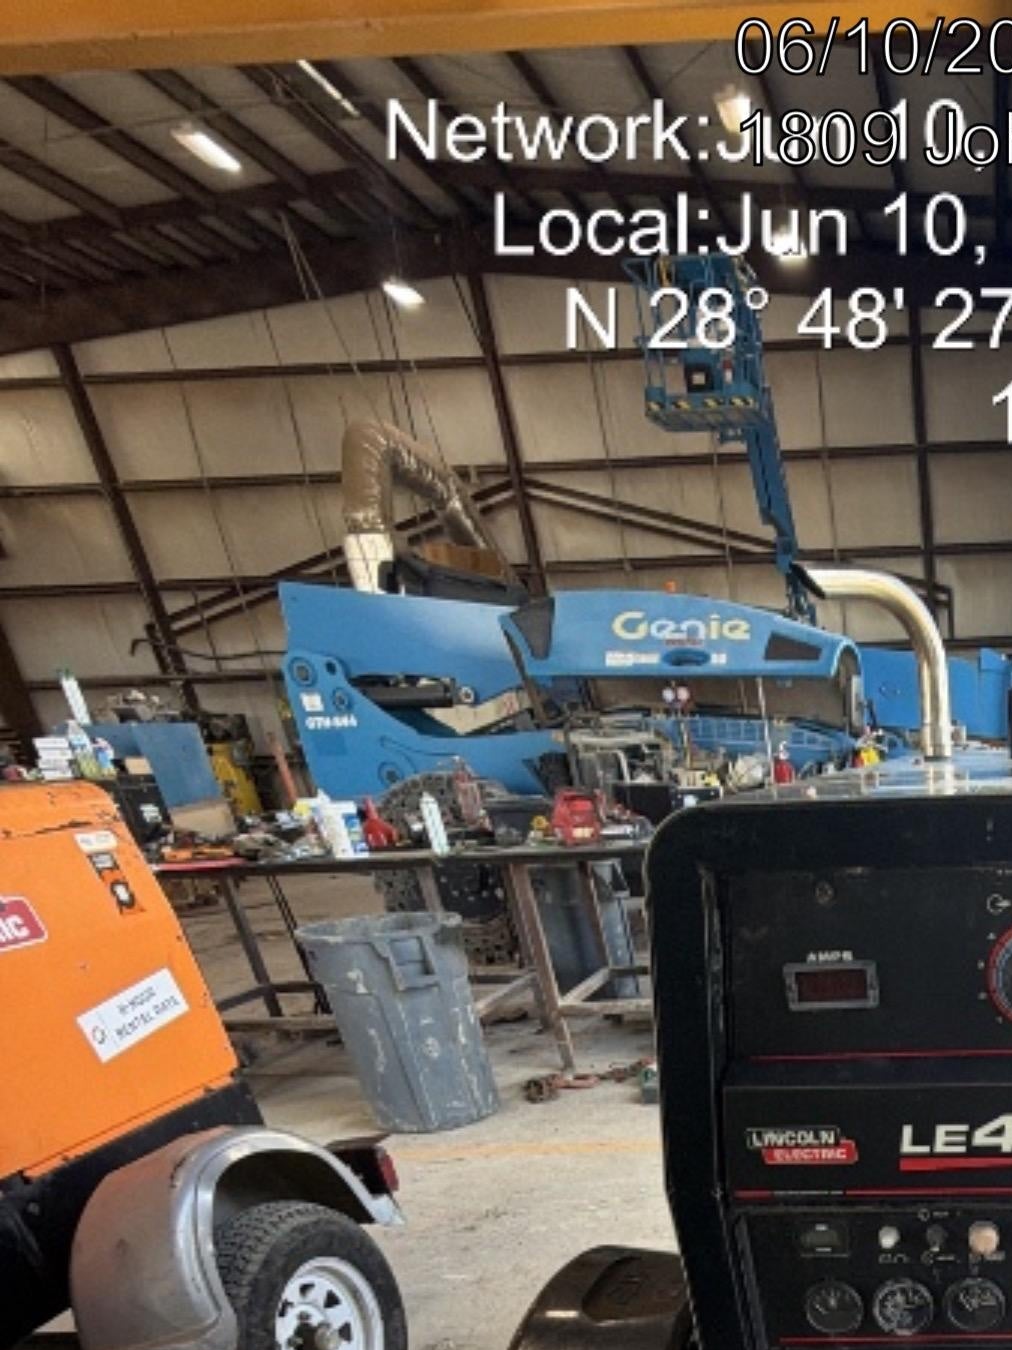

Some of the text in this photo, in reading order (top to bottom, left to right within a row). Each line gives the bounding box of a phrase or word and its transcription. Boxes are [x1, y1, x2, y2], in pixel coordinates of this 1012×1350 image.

[611, 611, 750, 640] Genie
[752, 1129, 836, 1146] LINCOLN
[773, 1146, 848, 1161] ELECTRIC
